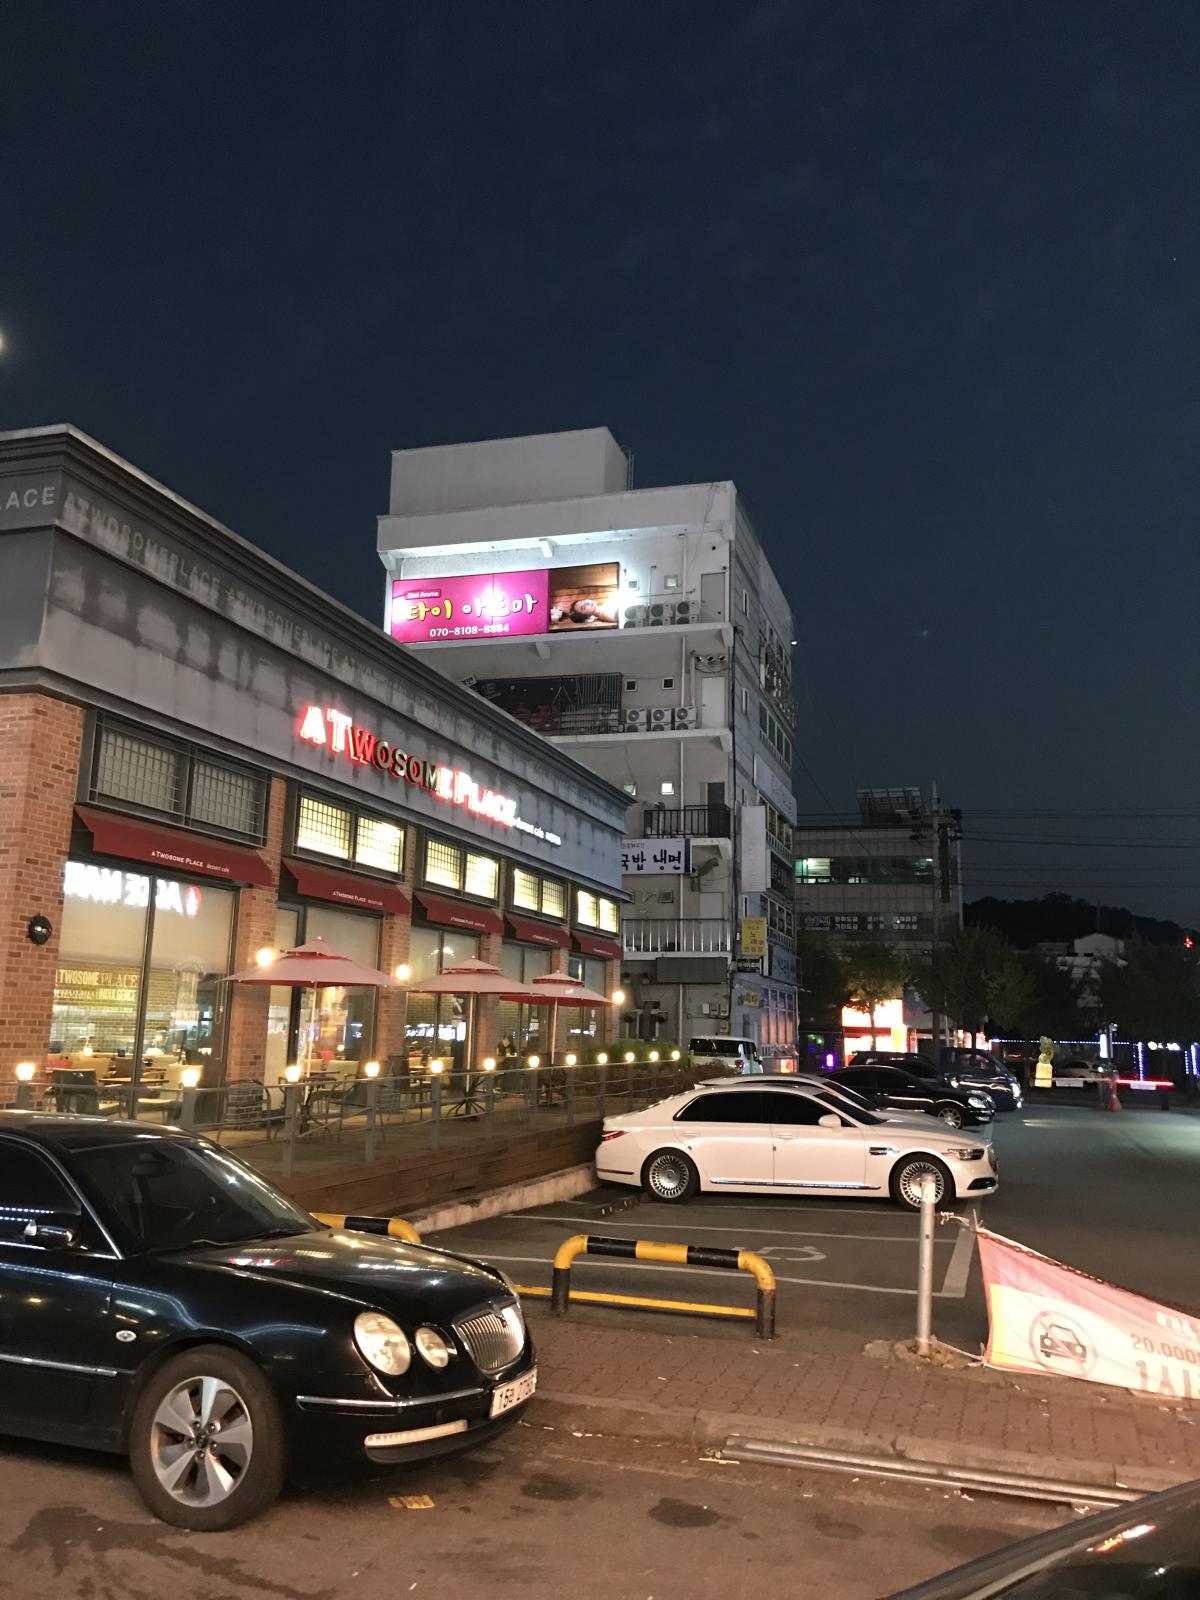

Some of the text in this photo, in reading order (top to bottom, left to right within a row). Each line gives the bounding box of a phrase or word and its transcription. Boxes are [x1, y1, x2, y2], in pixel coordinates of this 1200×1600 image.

[0, 486, 55, 510] ACE
[301, 706, 326, 744] A
[156, 851, 185, 863] TWOSOME
[185, 858, 204, 867] PLACE
[621, 849, 681, 871] 국밥 냉면
[1130, 1332, 1200, 1365] 20.000
